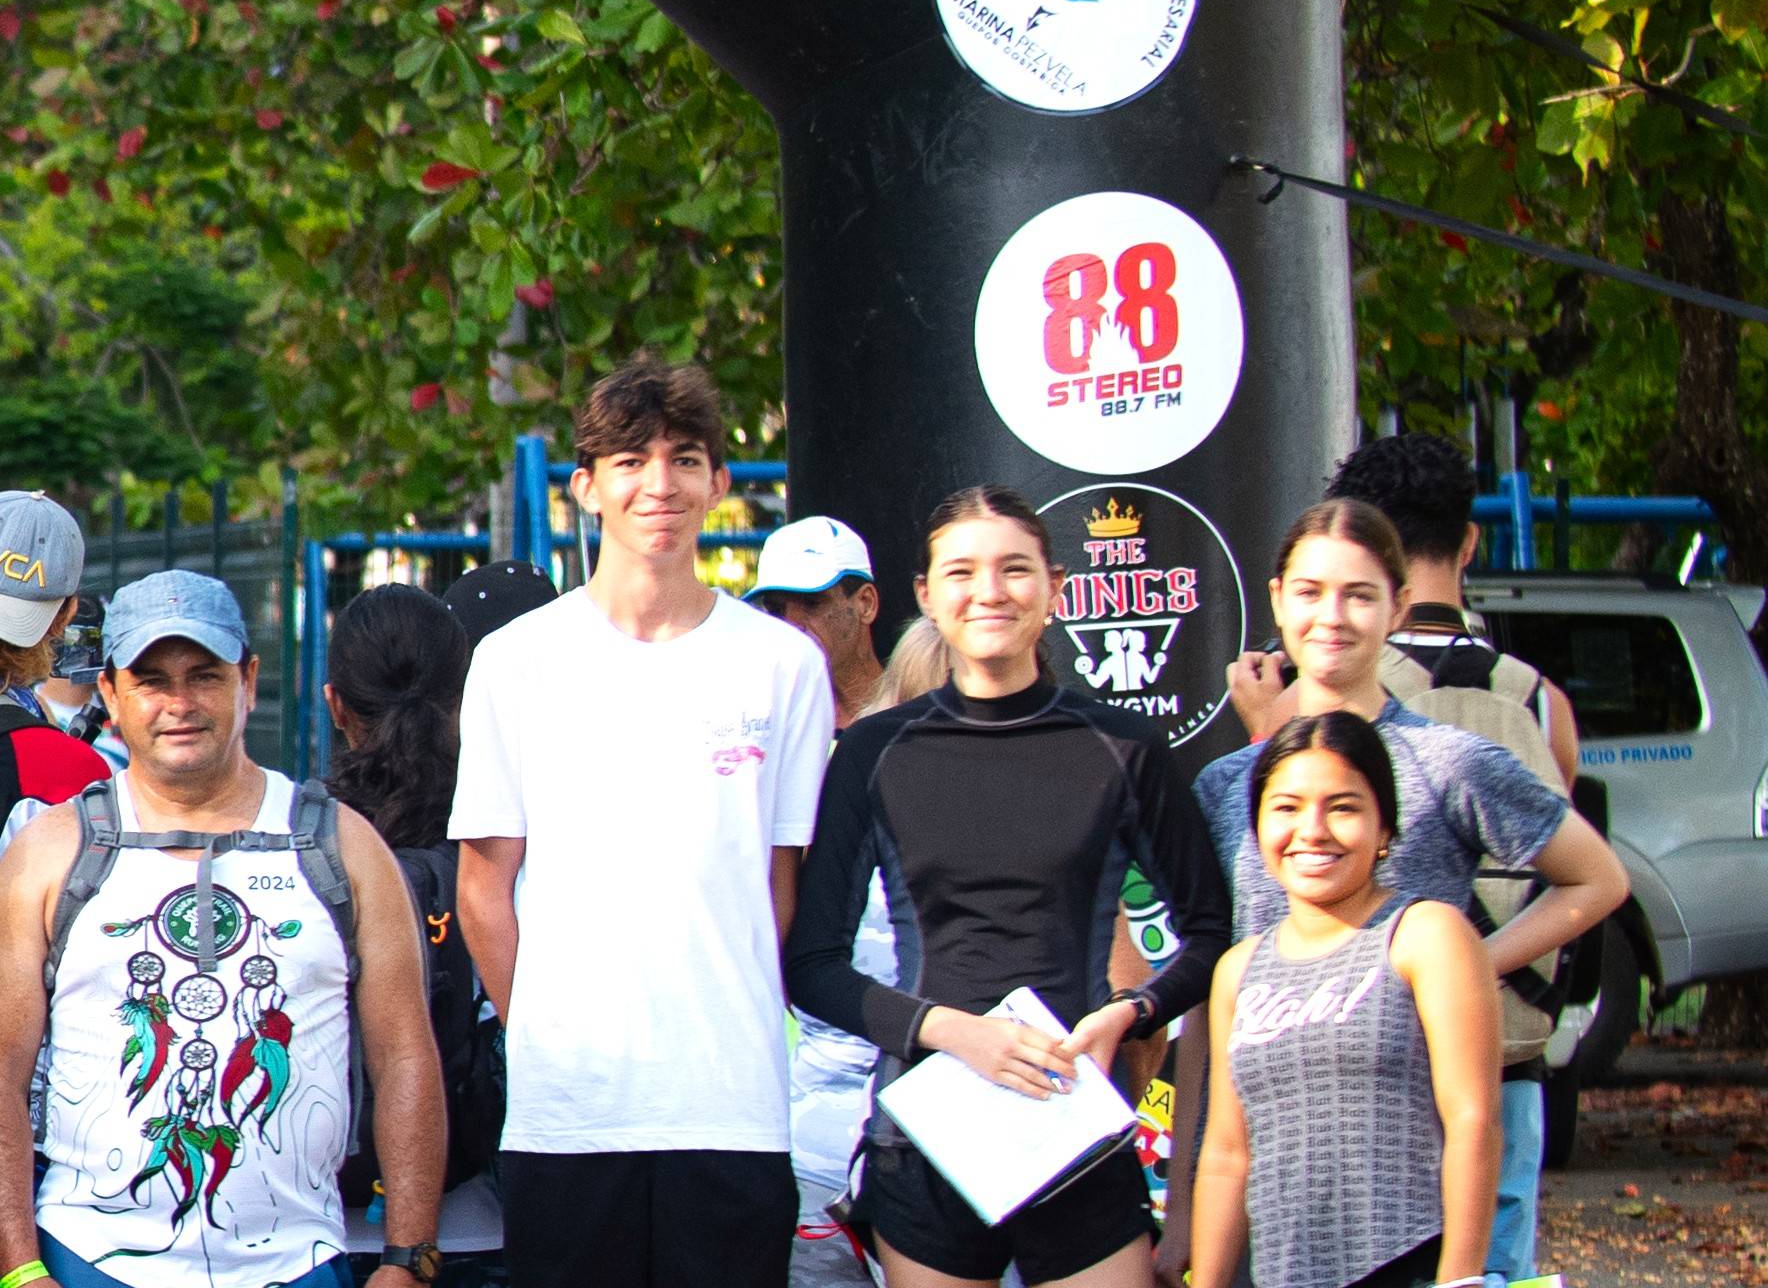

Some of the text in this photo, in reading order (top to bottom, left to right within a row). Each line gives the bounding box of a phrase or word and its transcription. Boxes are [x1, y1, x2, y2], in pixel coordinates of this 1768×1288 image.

[1042, 241, 1179, 376] 88
[1046, 363, 1184, 409] STEREO
[1099, 390, 1183, 418] 88.7 FM
[1084, 538, 1147, 567] THE
[1620, 743, 1694, 763] PRIVADO
[247, 875, 296, 891] 2024
